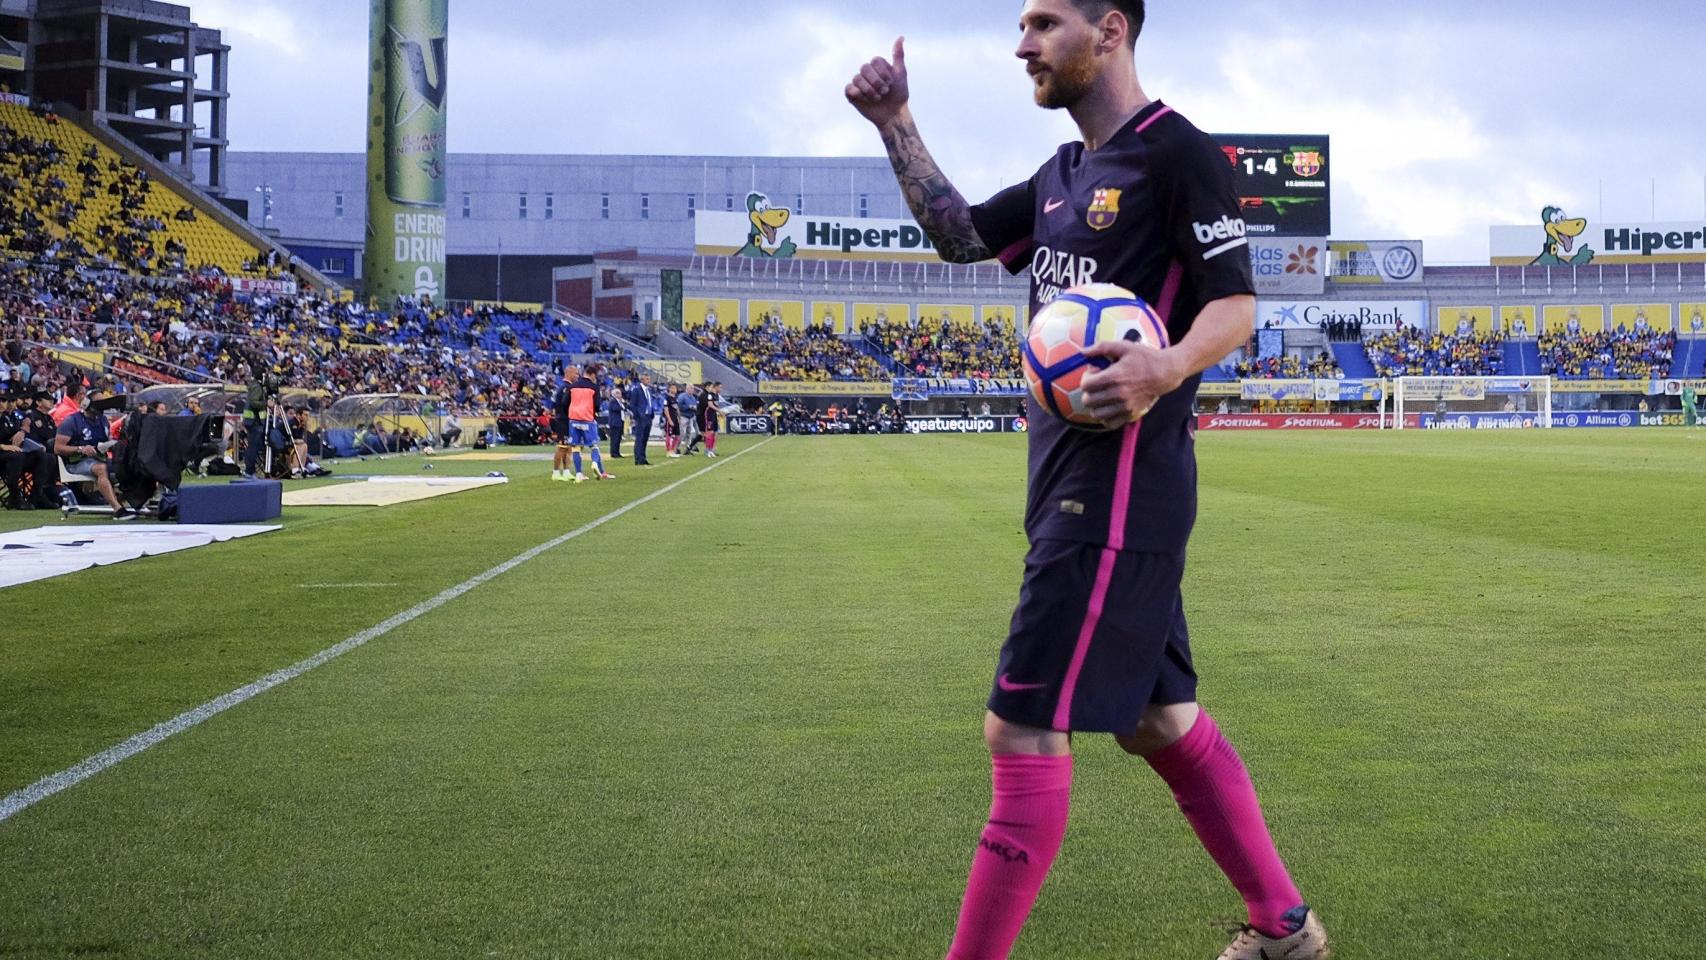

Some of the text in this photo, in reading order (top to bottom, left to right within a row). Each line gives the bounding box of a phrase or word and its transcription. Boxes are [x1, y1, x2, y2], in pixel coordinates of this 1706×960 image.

[1243, 157, 1278, 175] 1-4
[1192, 214, 1246, 244] beko
[1605, 228, 1706, 256] Hiper
[1032, 246, 1098, 287] QATAR
[1304, 306, 1403, 325] CaixaBank
[739, 417, 768, 430] HPS
[1586, 414, 1617, 425] Allianz
[1640, 414, 1685, 425] bet365
